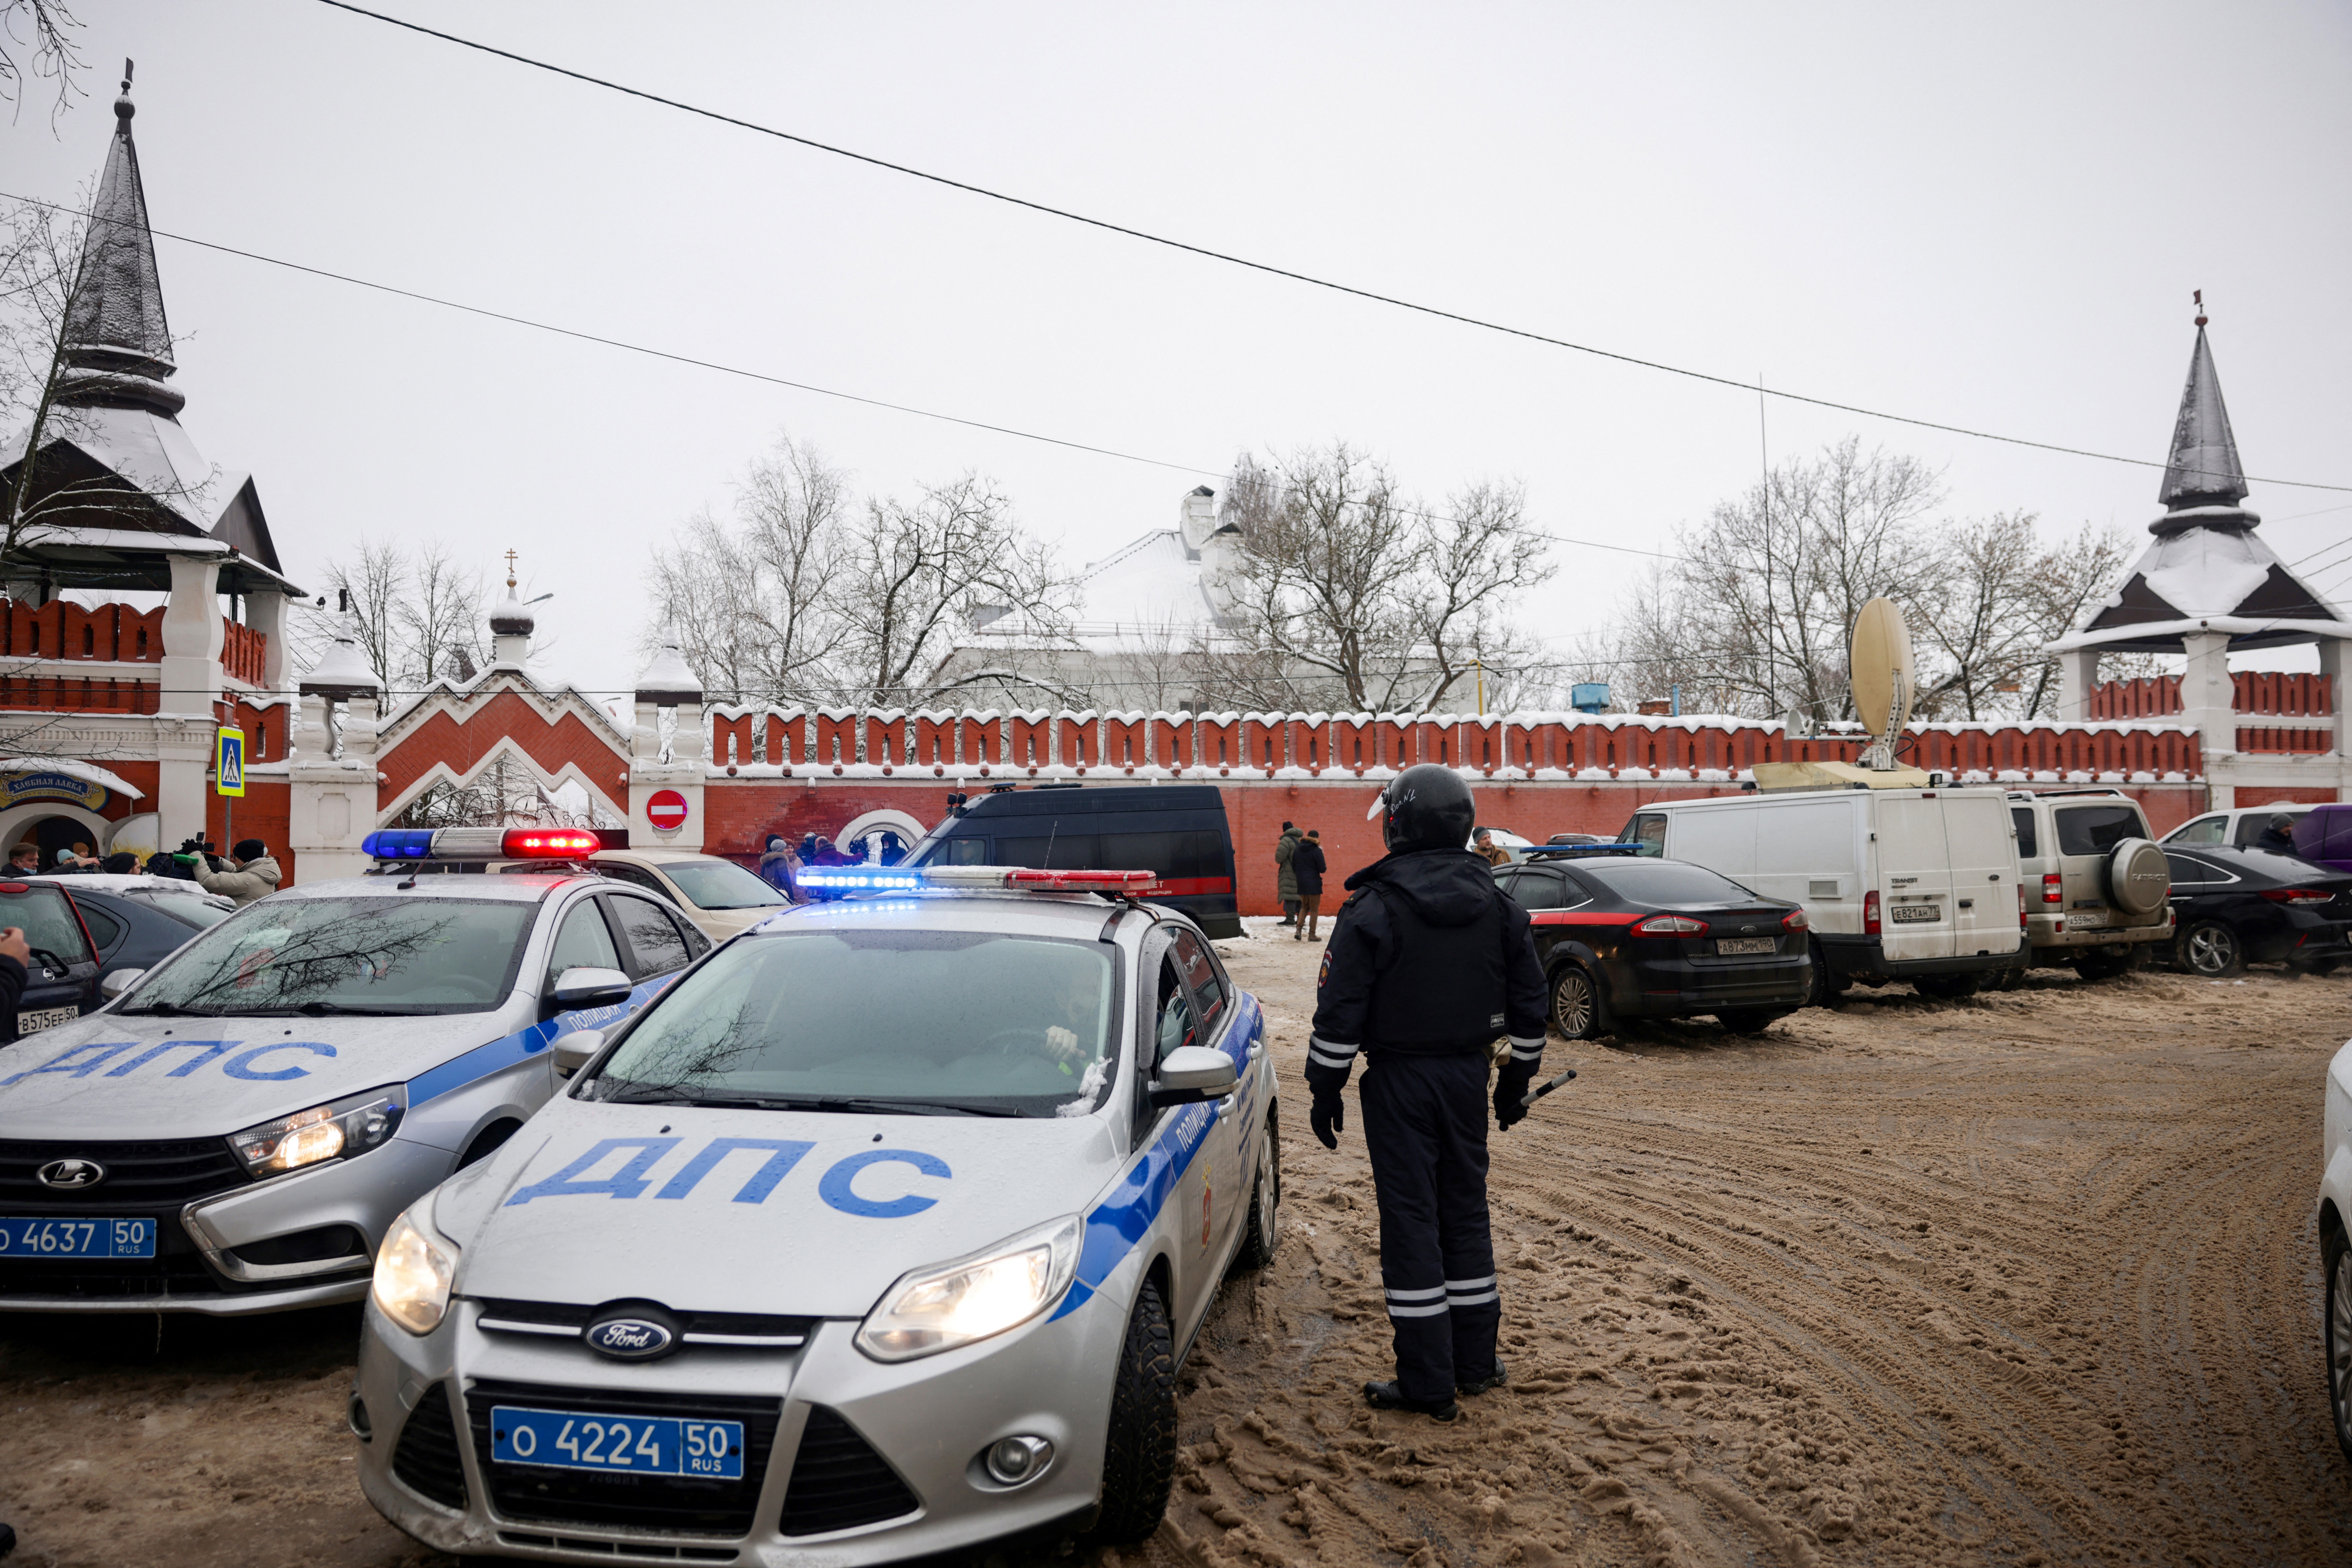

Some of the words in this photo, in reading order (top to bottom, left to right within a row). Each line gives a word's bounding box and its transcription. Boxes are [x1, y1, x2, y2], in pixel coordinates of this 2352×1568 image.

[13, 778, 53, 791] ХЛЕБНАЯ
[55, 779, 82, 792] ЛАВКА
[66, 1007, 75, 1020] 50
[567, 1004, 622, 1031] ПОЛИЦИЯ
[0, 1040, 337, 1086] ДПС
[1176, 1101, 1212, 1153] ПОЛИЦИЯ
[503, 1137, 952, 1218] ДПС
[22, 1223, 95, 1252] 4637
[115, 1222, 144, 1244] 50
[118, 1245, 140, 1254] RUS
[603, 1324, 651, 1348] Ford
[512, 1425, 537, 1457] О
[555, 1420, 659, 1467] 4224
[687, 1425, 728, 1458] 50
[692, 1458, 722, 1472] RUS
